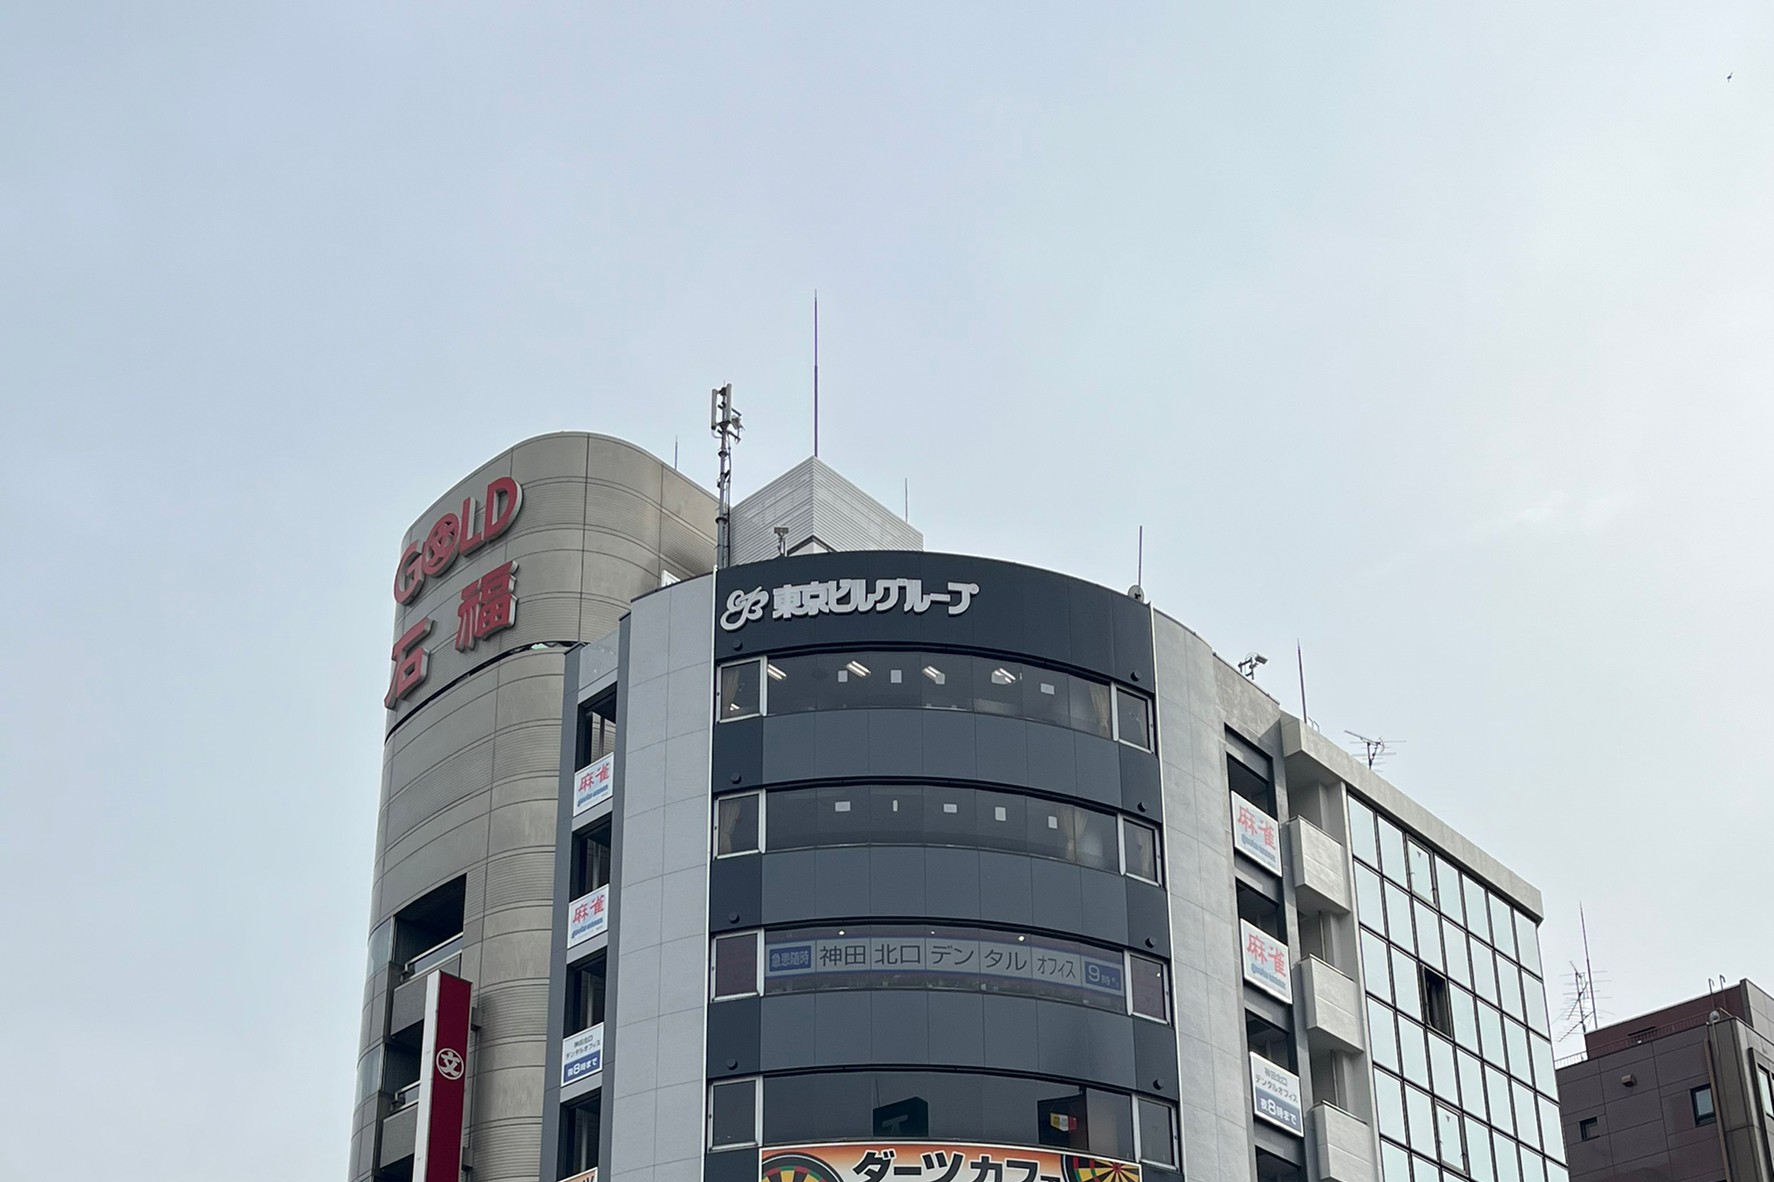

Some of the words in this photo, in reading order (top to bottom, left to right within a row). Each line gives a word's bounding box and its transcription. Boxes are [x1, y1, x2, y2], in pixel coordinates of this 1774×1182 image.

[394, 476, 523, 606] GOLD
[772, 578, 980, 618] 東京ビルグループ
[384, 560, 520, 710] 石福
[578, 762, 609, 792] 麻雀
[1238, 805, 1276, 850] 麻雀
[573, 895, 604, 923] 麻雀
[1247, 934, 1286, 977] 麻雀
